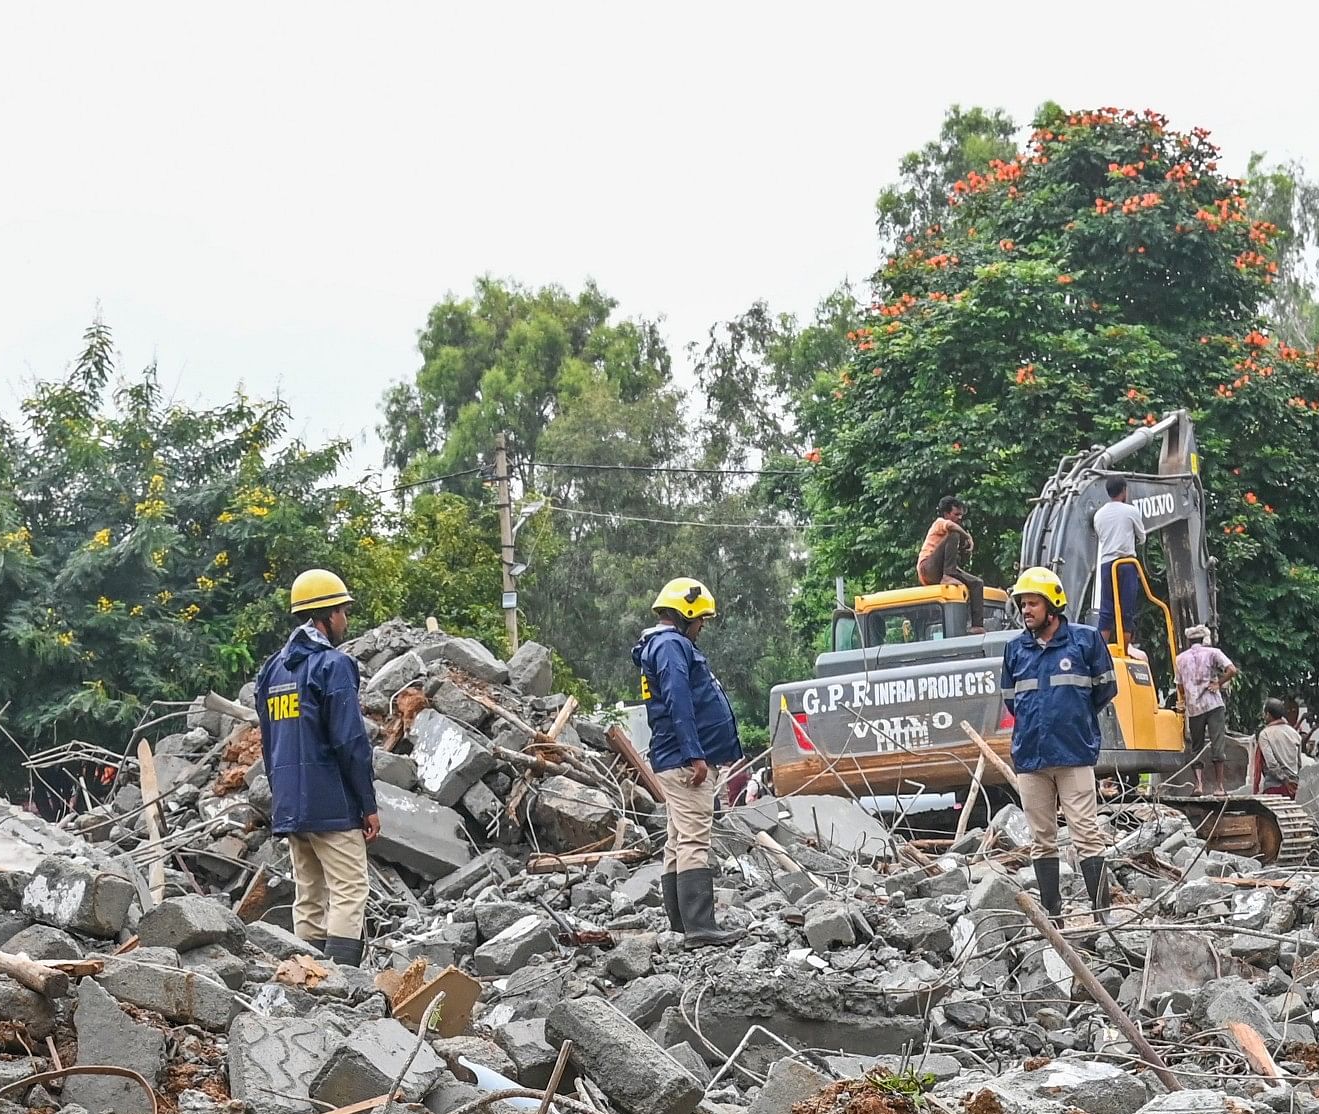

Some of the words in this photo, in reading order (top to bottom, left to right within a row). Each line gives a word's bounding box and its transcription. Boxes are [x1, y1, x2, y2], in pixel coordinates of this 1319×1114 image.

[1132, 493, 1175, 518] VOLVO
[874, 677, 916, 706] INFRA
[267, 692, 300, 722] FIRE
